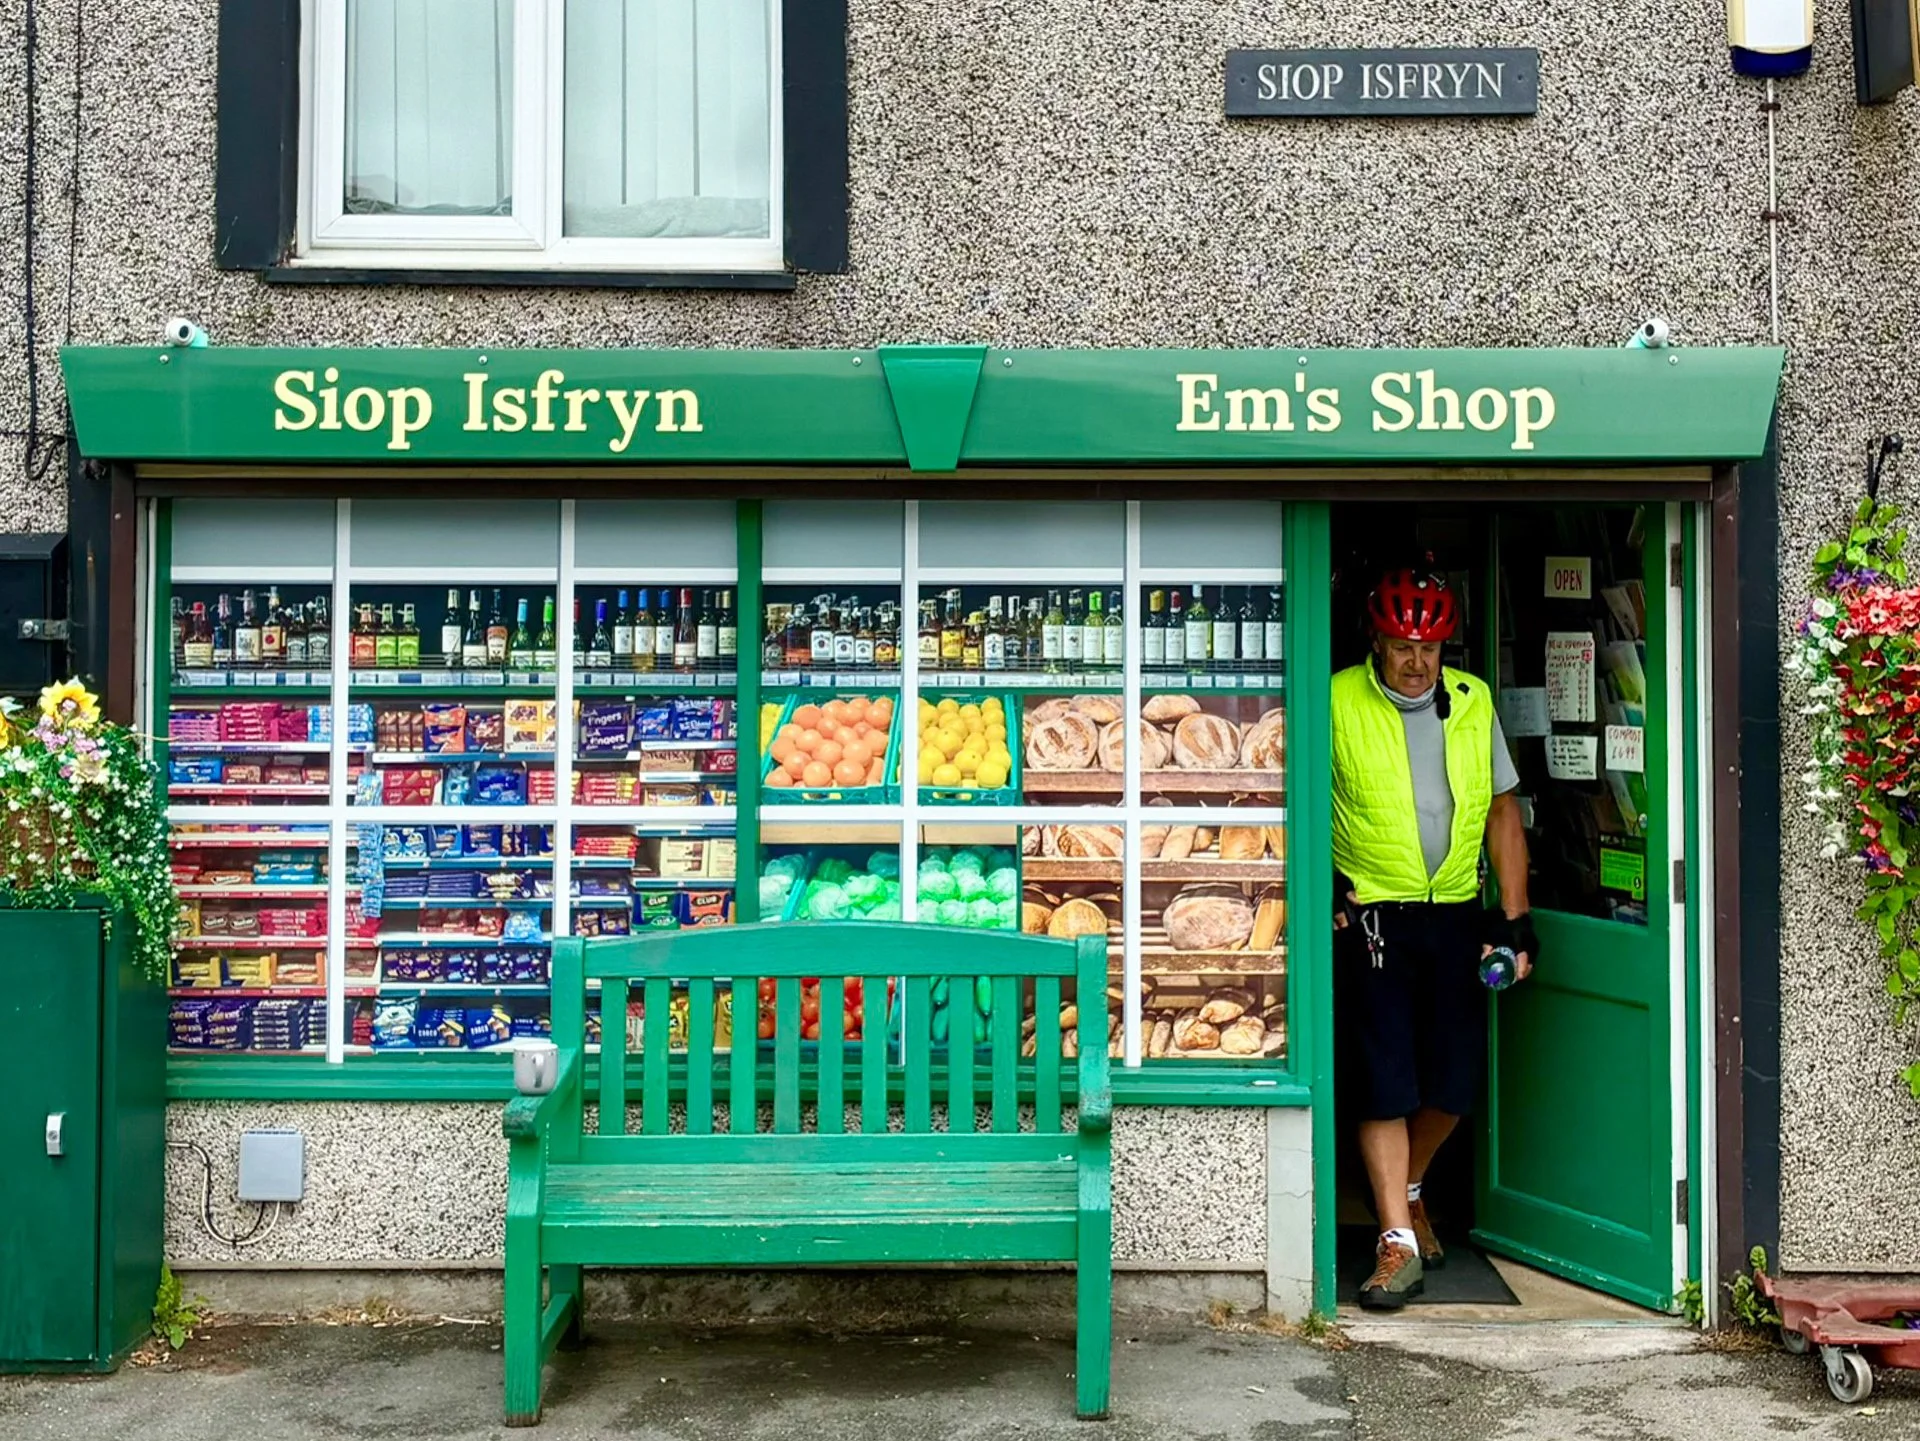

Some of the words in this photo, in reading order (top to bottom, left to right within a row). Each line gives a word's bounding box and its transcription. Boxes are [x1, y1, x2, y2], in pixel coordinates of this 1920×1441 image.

[1257, 63, 1344, 100] SIOP
[1359, 62, 1506, 99] ISFRYN
[273, 367, 432, 451] Siop
[462, 369, 704, 454] Isfryn
[1175, 372, 1342, 433] Em's
[1370, 369, 1556, 451] Shop
[1553, 569, 1583, 591] OPEN
[1608, 728, 1641, 743] COMPOST
[648, 896, 668, 906] CLUB
[696, 895, 718, 906] CLUB
